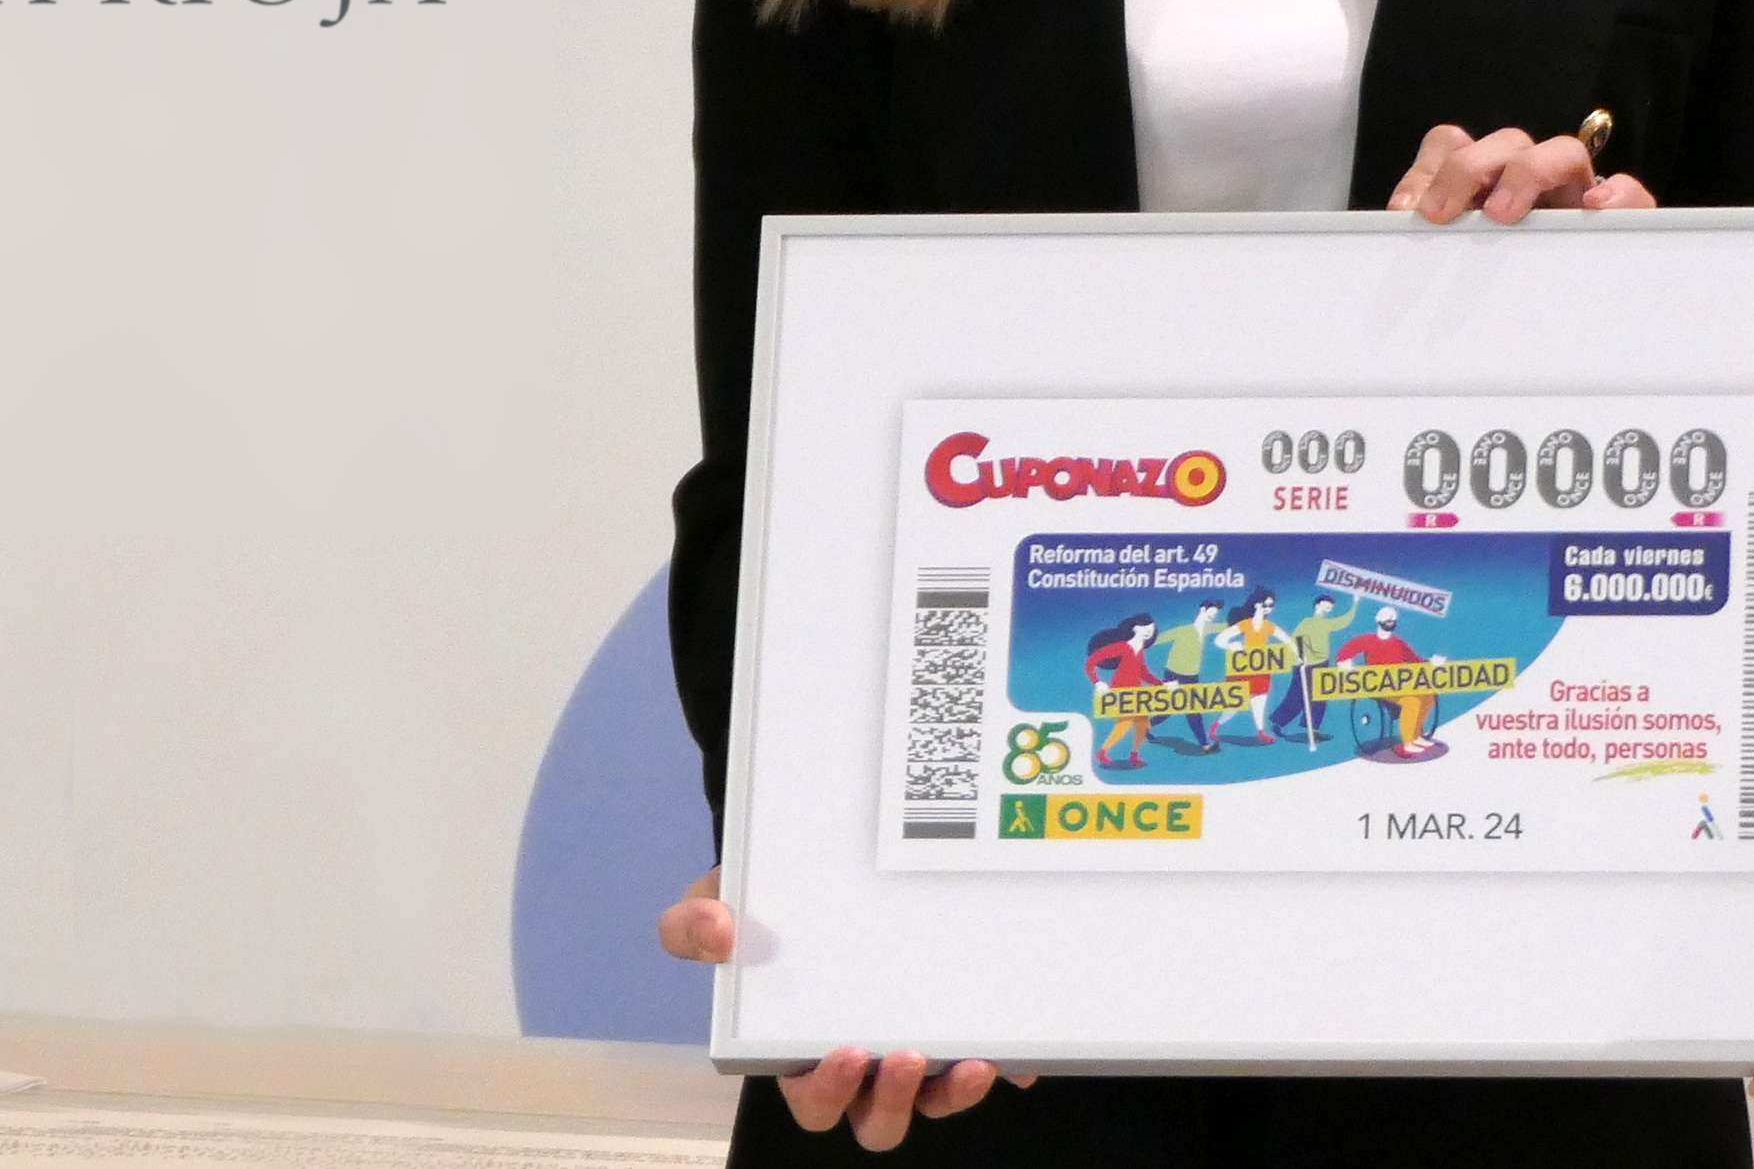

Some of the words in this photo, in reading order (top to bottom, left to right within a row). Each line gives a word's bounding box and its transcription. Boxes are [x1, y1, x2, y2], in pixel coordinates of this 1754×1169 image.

[1261, 428, 1367, 474] 000
[1403, 428, 1727, 510] 00000
[1271, 486, 1350, 511] SERIE
[1029, 544, 1116, 565] Reforma
[1119, 544, 1151, 564] del
[1154, 544, 1189, 564] art.
[1193, 544, 1218, 564] 49
[1565, 546, 1617, 567] Cada
[1624, 546, 1704, 567] viernes
[1028, 567, 1149, 589] Constitución
[1154, 568, 1245, 593] Española
[1322, 567, 1447, 614] DISMINUIDOS
[1564, 572, 1713, 604] 6.000.000€
[1231, 648, 1286, 674] CON
[1320, 662, 1510, 695] DISCAPACIDAD
[1549, 680, 1632, 703] Gracias
[1637, 685, 1649, 702] a
[1101, 685, 1244, 714] PERSONAS
[1475, 711, 1558, 731] vuestra
[1565, 706, 1634, 730] ilusión
[1642, 712, 1722, 735] somos,
[1001, 721, 1070, 785] 85
[1488, 739, 1537, 760] ante
[1542, 737, 1597, 763] todo,
[1604, 739, 1707, 764] personas
[1058, 801, 1191, 832] ONCE
[1358, 814, 1371, 840] 1
[1387, 814, 1474, 840] MAR.
[1484, 813, 1523, 840] 24
